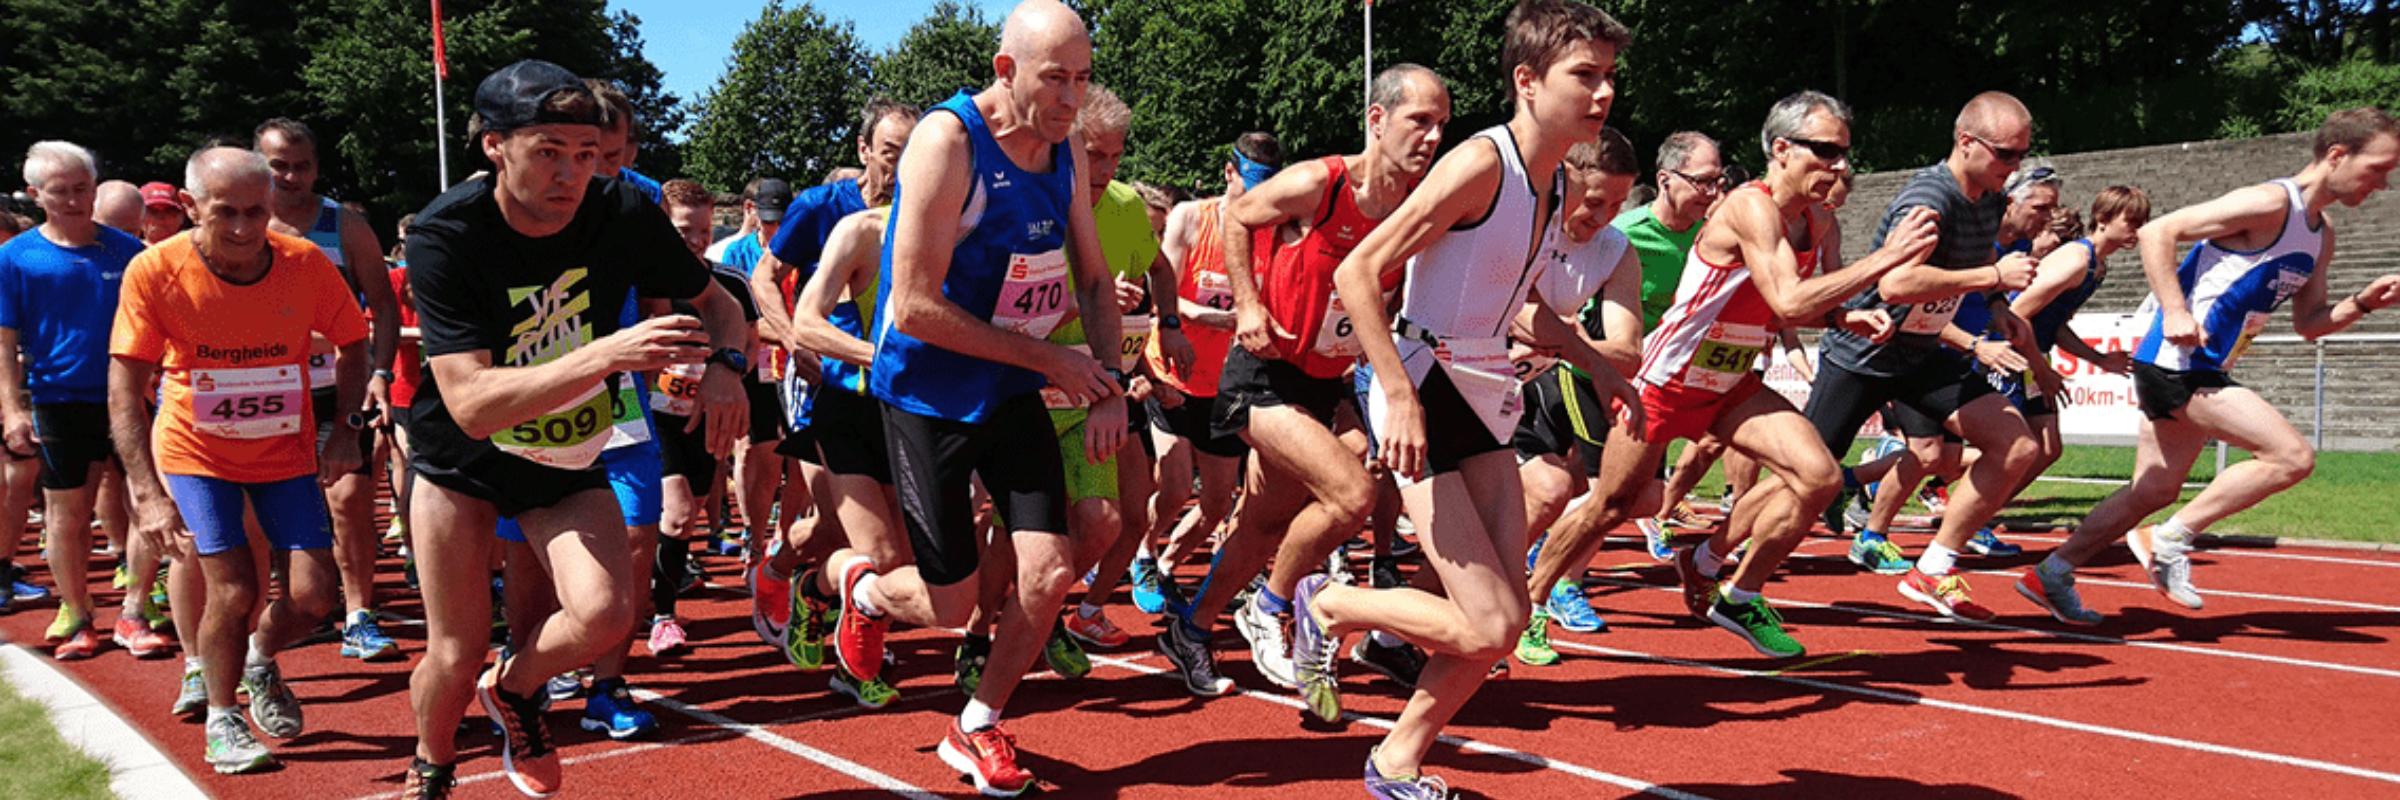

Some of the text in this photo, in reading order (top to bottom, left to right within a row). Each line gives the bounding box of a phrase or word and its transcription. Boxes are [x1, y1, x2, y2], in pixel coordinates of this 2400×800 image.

[1014, 281, 1062, 314] 470
[196, 342, 289, 364] Bergheide
[1706, 345, 1754, 371] 541
[210, 394, 286, 420] 455
[512, 406, 598, 444] 509
